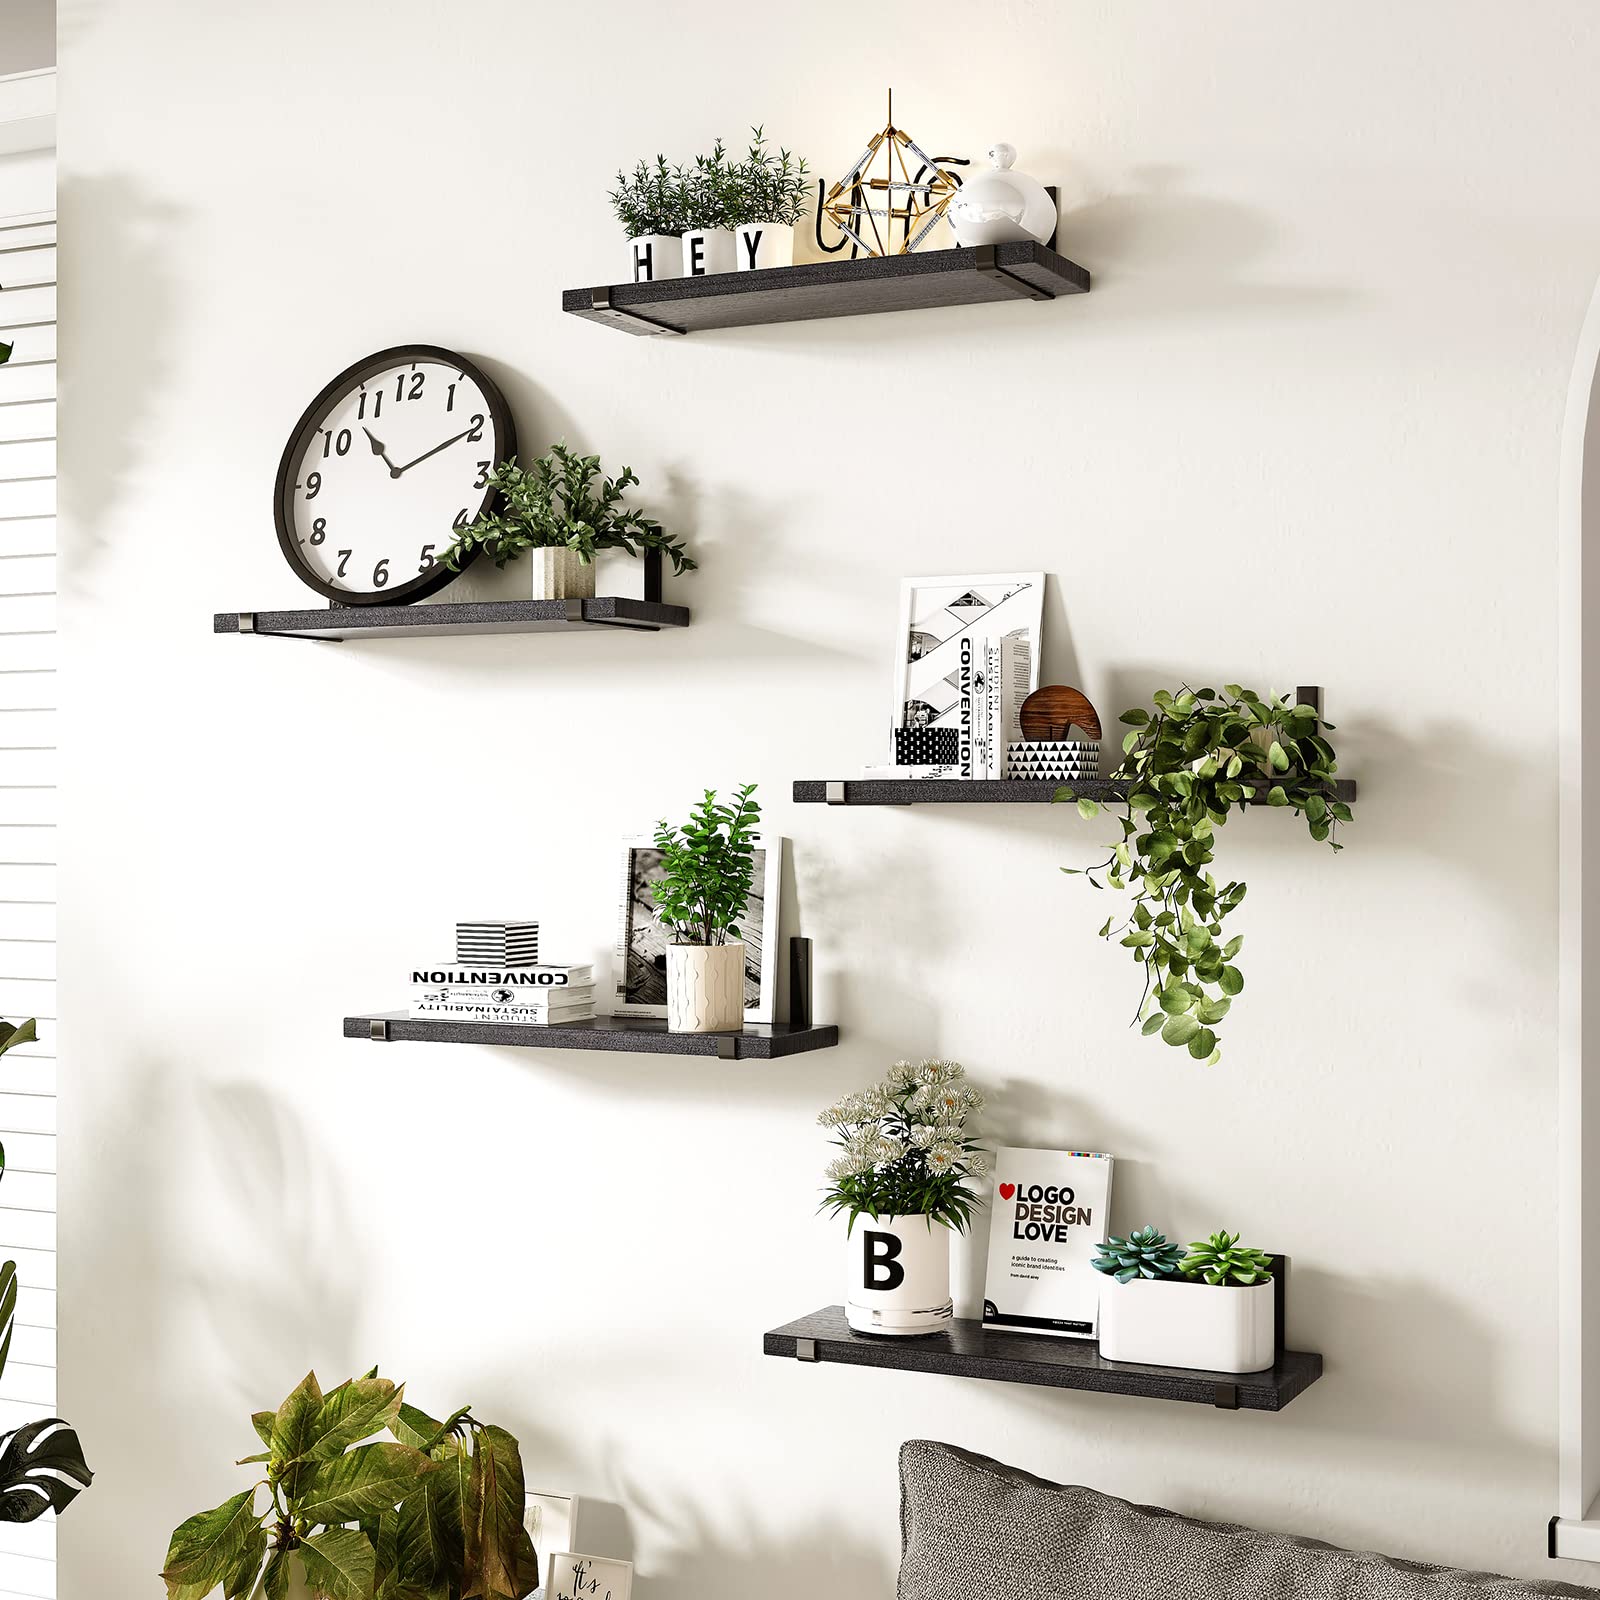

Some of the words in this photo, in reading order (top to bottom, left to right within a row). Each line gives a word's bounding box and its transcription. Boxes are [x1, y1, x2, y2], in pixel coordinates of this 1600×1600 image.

[396, 373, 425, 402] 12
[447, 384, 456, 411] 1
[358, 391, 384, 420] 11
[467, 413, 485, 442] 2
[323, 429, 352, 458] 10
[305, 472, 322, 499] 9
[473, 461, 491, 490] 3
[309, 518, 327, 545] 8
[337, 549, 353, 577] 7
[419, 544, 436, 573] 5
[373, 559, 389, 588] 6
[960, 637, 971, 776] CONVENTION
[412, 971, 569, 986] CONVENTION
[418, 1004, 537, 1015] SUSTAINABILITY
[474, 1013, 537, 1022] STUDENT
[1016, 1184, 1075, 1206] LOGO
[1015, 1203, 1092, 1226] DESIGN
[1013, 1221, 1068, 1243] LOVE
[864, 1230, 905, 1291] B
[572, 1560, 601, 1597] It's
